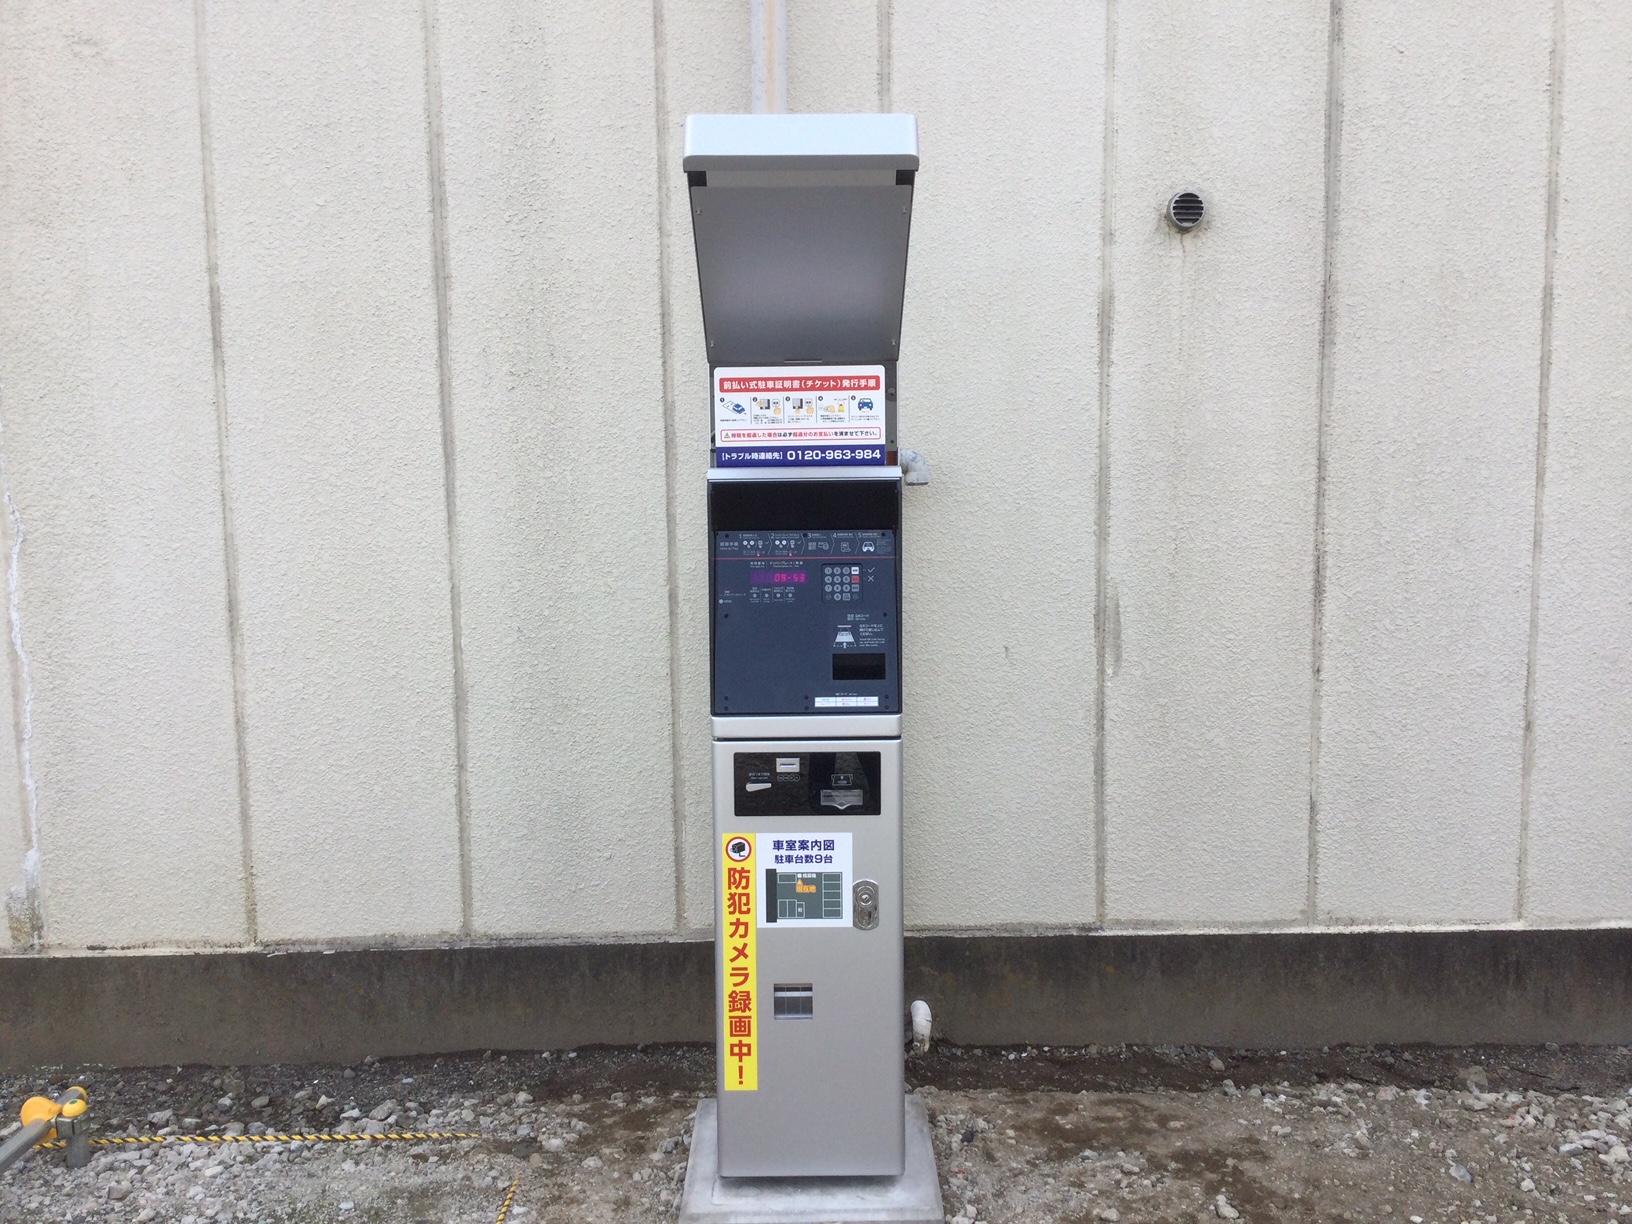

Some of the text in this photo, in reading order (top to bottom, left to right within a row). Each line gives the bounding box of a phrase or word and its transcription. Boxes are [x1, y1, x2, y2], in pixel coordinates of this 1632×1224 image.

[787, 449, 881, 460] 0120-963-984
[773, 839, 835, 851] 車室案内図
[774, 854, 833, 864] 駐車台数9台
